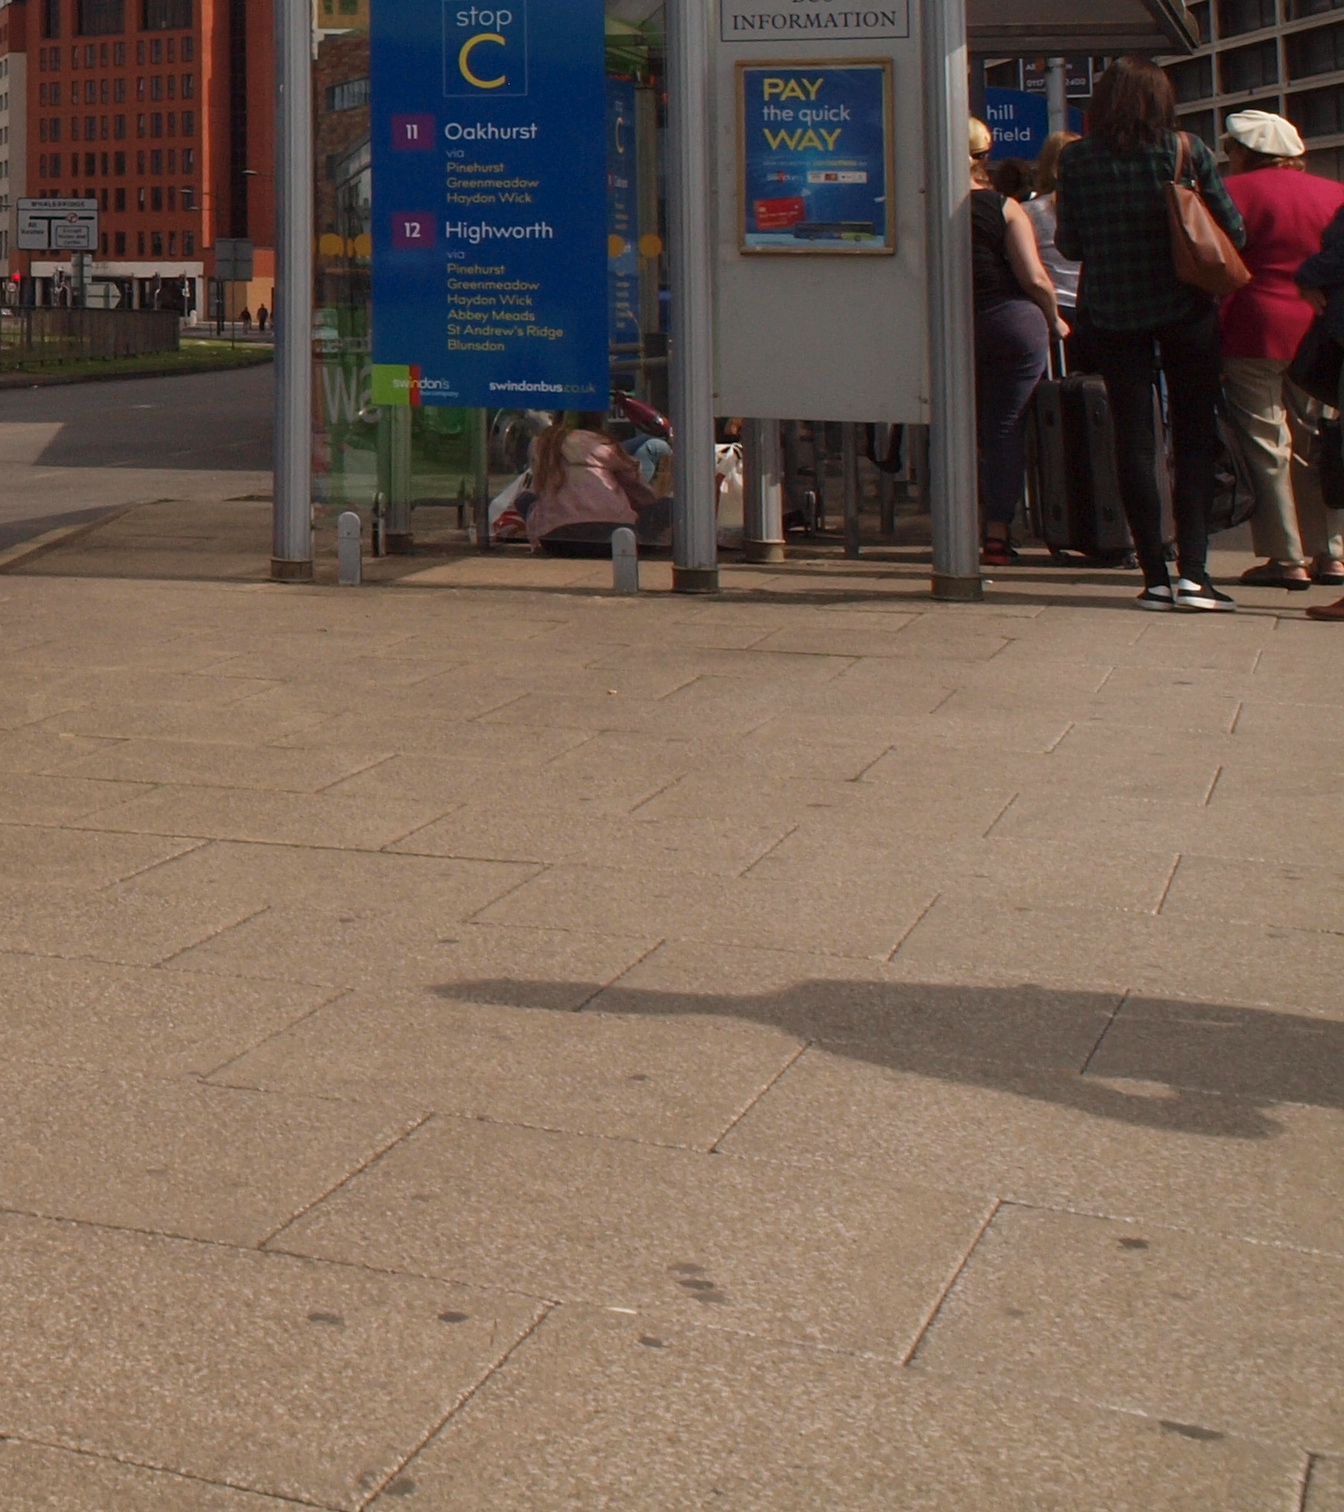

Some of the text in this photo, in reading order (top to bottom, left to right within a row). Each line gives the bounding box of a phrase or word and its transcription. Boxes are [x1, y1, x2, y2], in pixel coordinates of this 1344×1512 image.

[455, 5, 513, 33] stop
[732, 10, 897, 31] INFORMATION
[458, 32, 507, 89] C
[763, 77, 824, 102] PAY
[762, 103, 852, 130] the quick
[405, 121, 538, 141] 11 Oakhurst
[763, 127, 843, 151] WAY
[445, 148, 465, 158] via
[446, 161, 505, 173] Pinehurst
[446, 176, 540, 189] Greenmeadow
[446, 192, 533, 207] Haydon Wick
[404, 221, 553, 245] 12 Highworth
[446, 250, 466, 260] via
[447, 263, 506, 275] Pinehurst
[447, 278, 540, 291] Greenmeadow
[447, 294, 533, 308] Haydon Wick
[447, 309, 536, 323] Abbey Meads
[447, 324, 564, 340] St Andrew's Ridge
[447, 339, 505, 352] Blunsdon
[392, 377, 596, 394] swindon's swindonbus.co.uk
